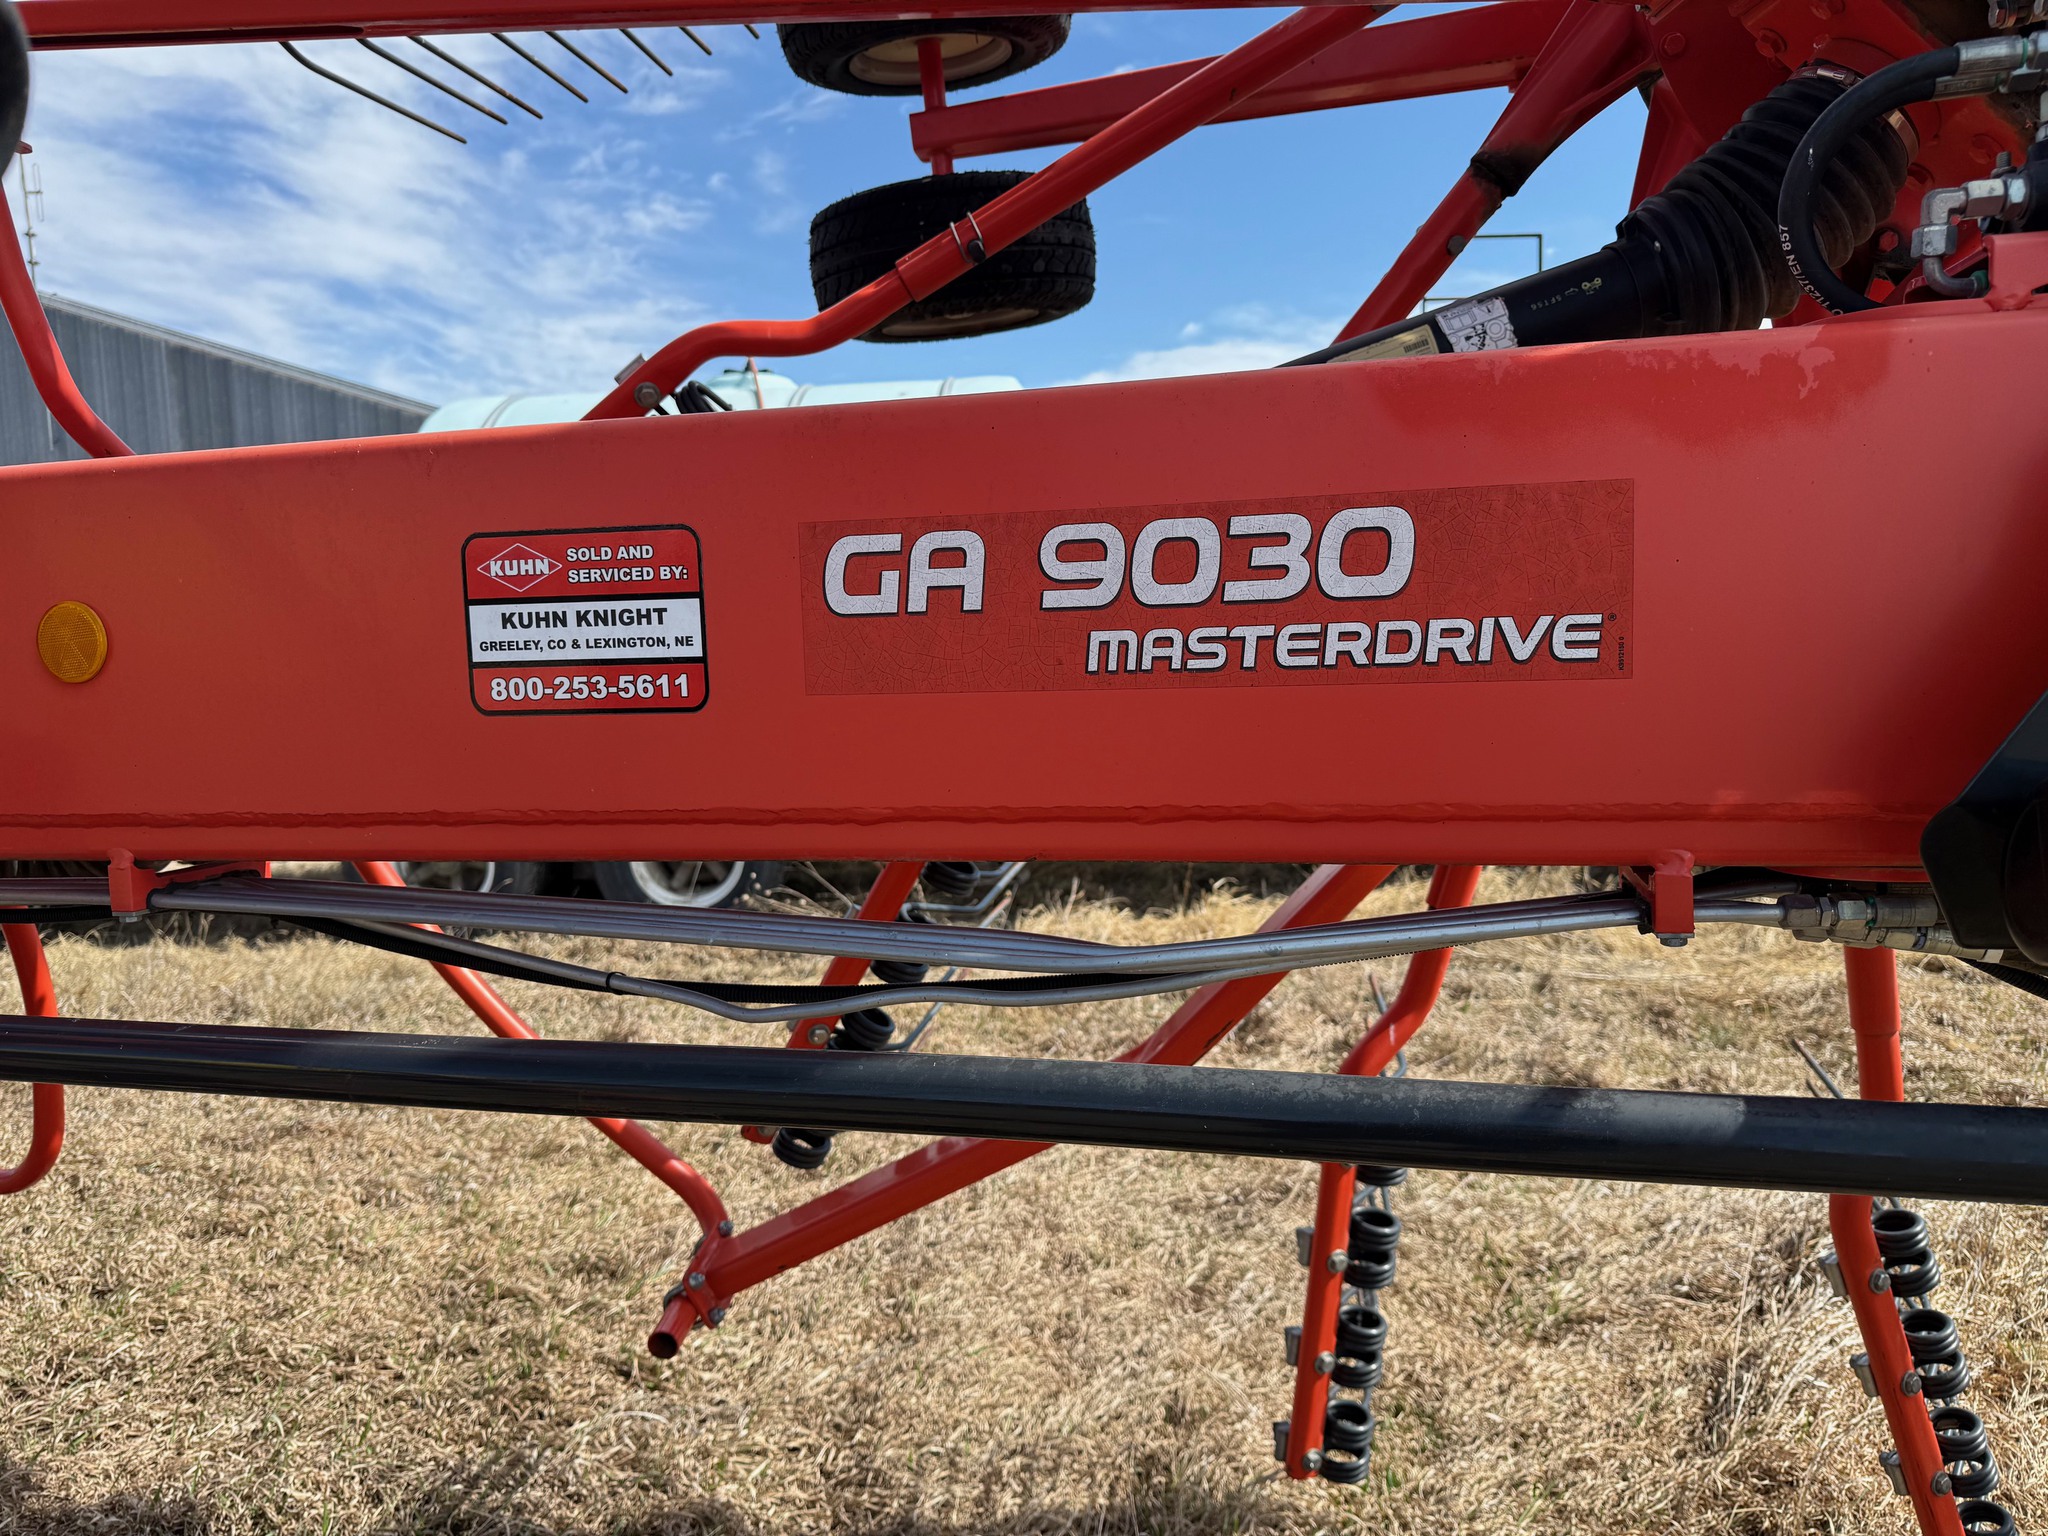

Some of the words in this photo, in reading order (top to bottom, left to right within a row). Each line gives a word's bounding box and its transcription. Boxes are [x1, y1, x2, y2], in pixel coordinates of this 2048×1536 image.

[1778, 224, 1792, 251] 857
[566, 547, 612, 562] SOLD
[617, 545, 654, 560] AND
[822, 530, 985, 617] GA
[1038, 505, 1416, 611] 9030
[490, 558, 550, 577] KUHN
[568, 566, 655, 583] SERVICED
[659, 565, 688, 580] BY:
[501, 611, 568, 629] KUHN
[576, 608, 667, 628] KNIGHT
[480, 640, 543, 652] GREELEY,
[548, 639, 566, 650] CO
[571, 639, 581, 649] &
[586, 637, 671, 649] LEXINGTON,
[675, 636, 694, 647] NE
[1085, 613, 1604, 675] MASTERDRIVE
[490, 673, 689, 701] 800-253-5611
